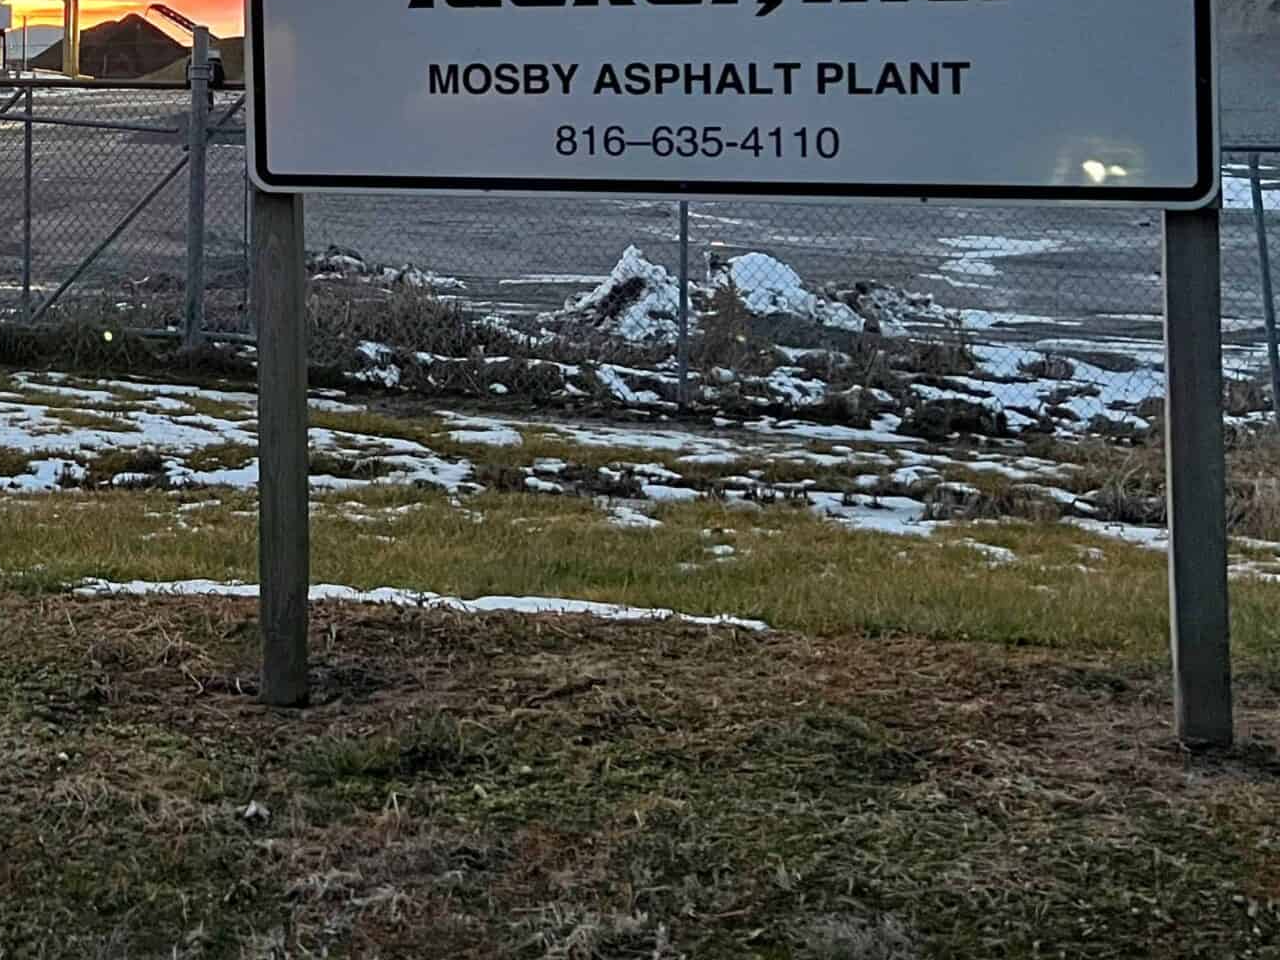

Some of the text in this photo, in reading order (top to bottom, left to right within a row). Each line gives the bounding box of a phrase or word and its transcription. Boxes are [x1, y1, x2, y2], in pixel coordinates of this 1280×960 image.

[428, 61, 971, 96] MOSBY ASPHALT PLANT
